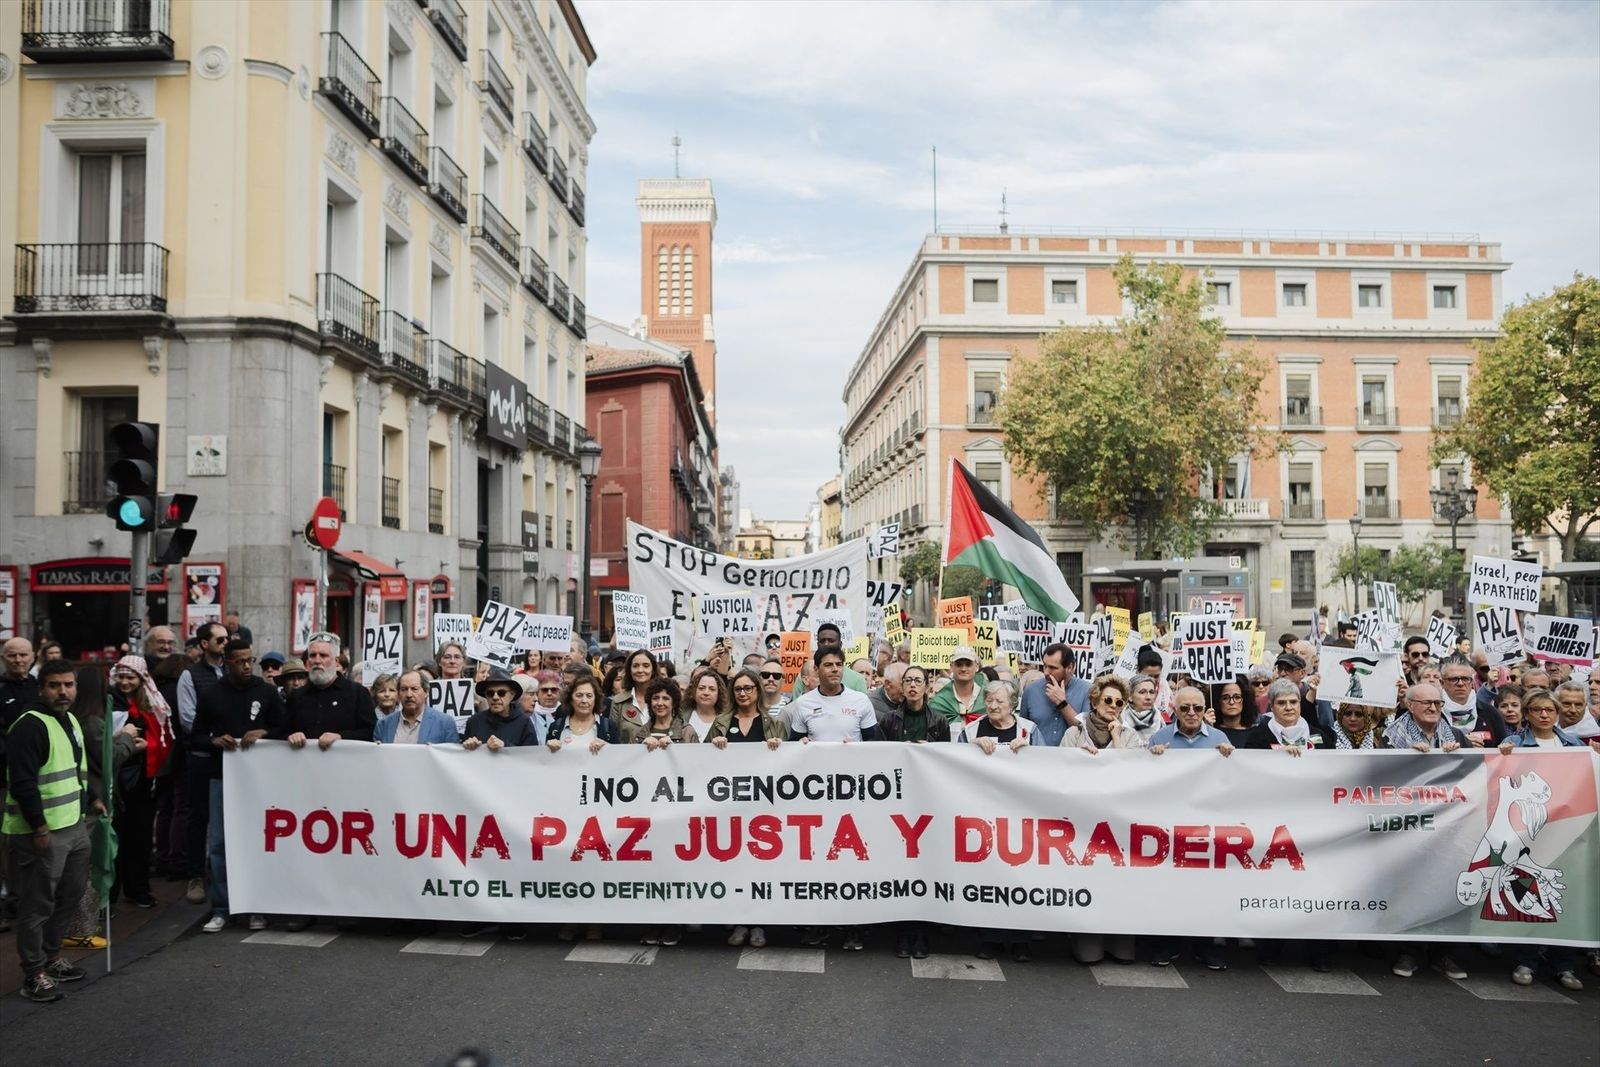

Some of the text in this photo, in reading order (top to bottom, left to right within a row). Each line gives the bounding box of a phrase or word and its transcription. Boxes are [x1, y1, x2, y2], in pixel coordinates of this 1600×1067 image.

[880, 524, 899, 556] PAZ
[635, 532, 717, 576] STOP
[39, 570, 82, 584] TAPAS
[91, 570, 163, 584] RACIES
[1474, 562, 1541, 584] Israel, peor
[614, 592, 645, 605] BOICOT
[867, 580, 902, 607] PAZ
[615, 604, 646, 616] ISRAEL:
[701, 598, 753, 615] JUSTICIA
[883, 604, 899, 618] PAZ
[945, 603, 967, 614] JUST
[1376, 583, 1400, 624] PAZ
[436, 618, 471, 633] JUSTICIA
[477, 602, 527, 644] PAZ
[650, 618, 672, 632] PAZ
[702, 617, 754, 633] Y PAZ.
[943, 614, 973, 626] PEACE
[1024, 616, 1050, 631] JUST
[1476, 606, 1518, 644] PAZ
[522, 620, 571, 643] Pact peace!
[1060, 628, 1094, 646] JUST
[1186, 620, 1227, 642] JUST
[1427, 618, 1454, 648] PAZ
[1549, 621, 1580, 639] WAR
[364, 625, 401, 661] PAZ
[650, 635, 672, 649] JUSTA
[785, 640, 807, 652] JUST
[944, 634, 960, 646] total
[1537, 636, 1591, 658] CRIMES!
[781, 656, 809, 668] PEACE
[912, 651, 953, 664] al Israel rac
[974, 646, 994, 660] USTA
[1188, 646, 1233, 681] PEACE
[429, 680, 473, 717] PAZ
[651, 776, 694, 803] AL
[707, 768, 903, 805] GENOCIDIO!
[1333, 785, 1468, 806] PALESTINA
[1368, 813, 1436, 833] LIBRE
[264, 806, 1306, 871] POR UNA PAZ JUSTA Y DURADERA
[421, 879, 480, 898] ALTO
[488, 880, 513, 898] EL
[521, 881, 595, 899] FUEGO
[603, 881, 727, 902] DEFINITIVO
[751, 881, 773, 901] NI
[780, 878, 928, 901] TERRORISMO
[935, 881, 955, 902] NI
[963, 884, 1092, 908] GENOCIDIO
[1239, 896, 1389, 914] pararlaguerra.es
